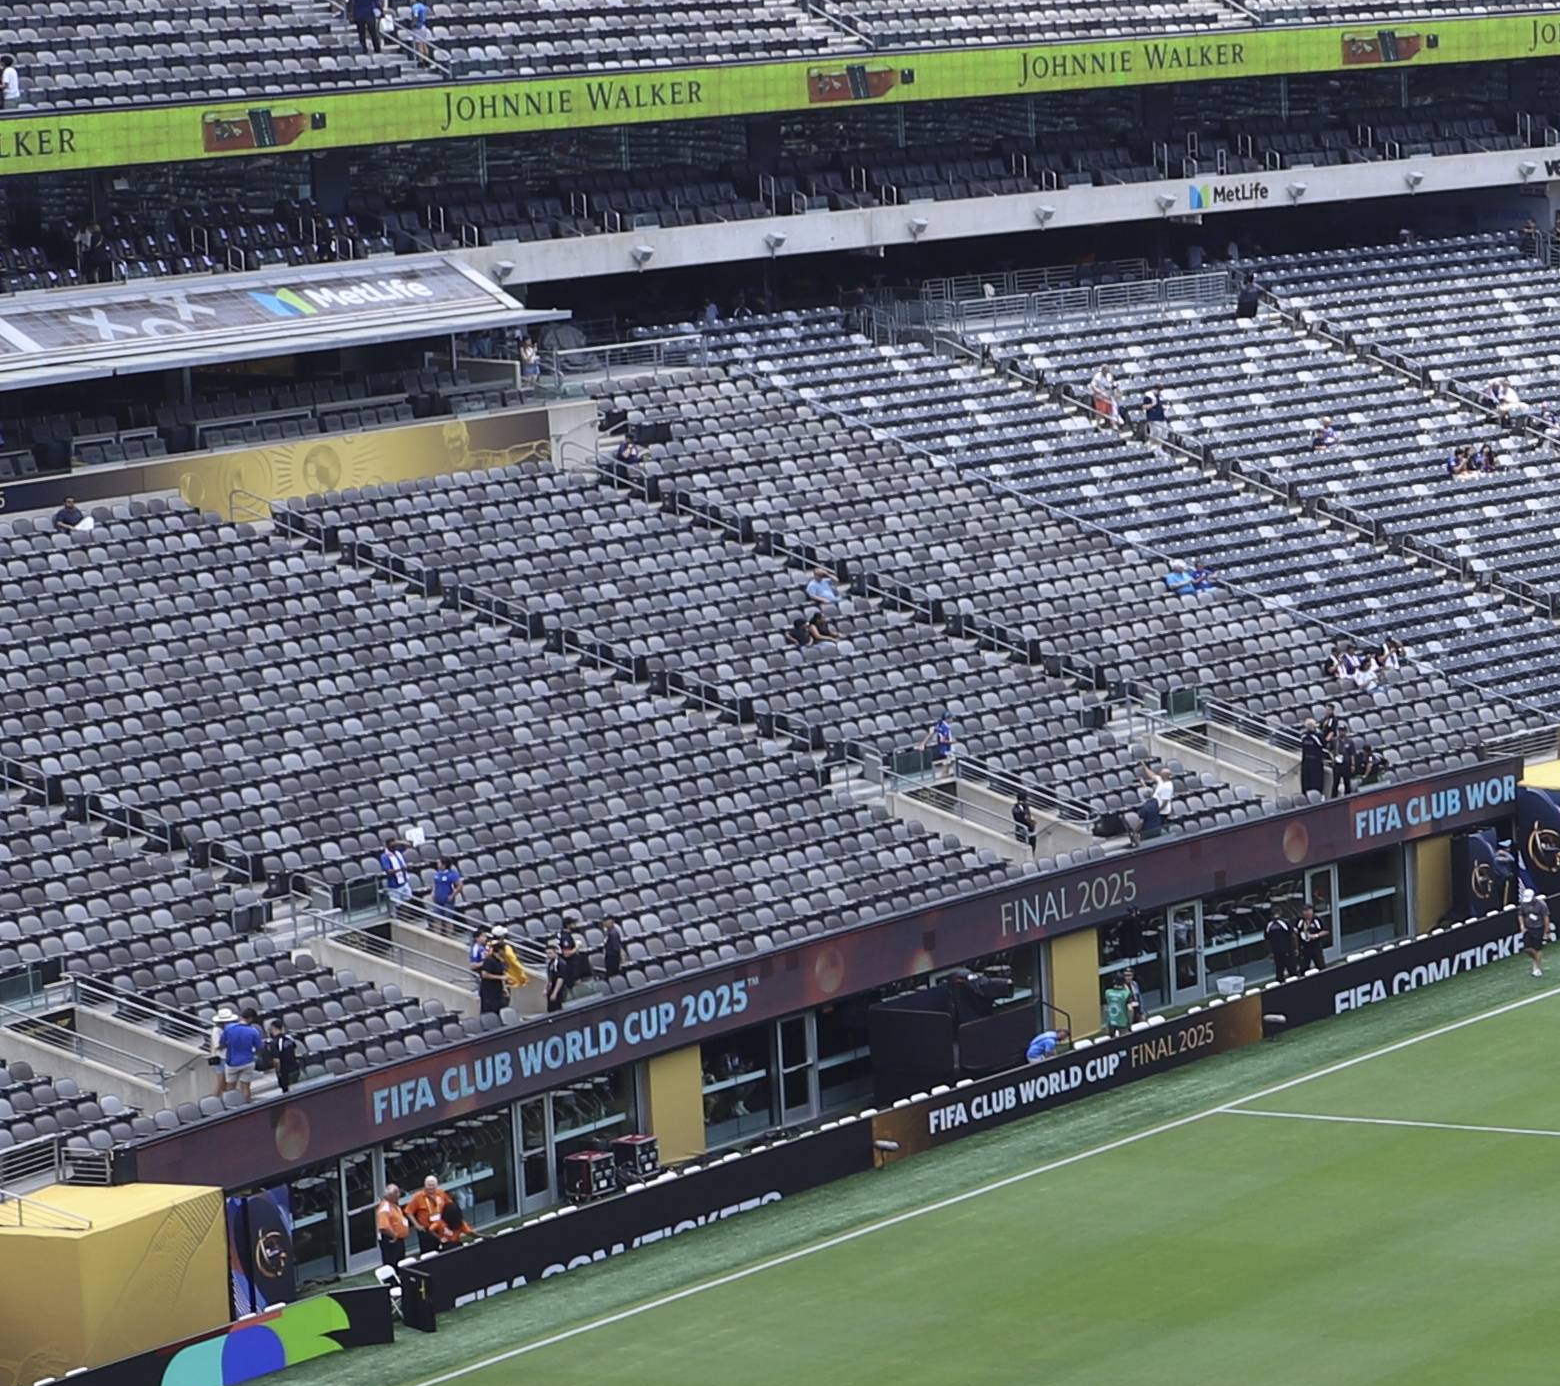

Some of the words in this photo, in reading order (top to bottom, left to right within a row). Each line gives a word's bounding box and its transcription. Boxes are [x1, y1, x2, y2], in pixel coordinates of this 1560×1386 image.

[1018, 50, 1132, 87] JOHNNIE
[1143, 43, 1245, 70] WALKER
[441, 90, 573, 131] JOHNNIE
[586, 80, 703, 112] WALKER
[1213, 182, 1268, 204] MetLife
[304, 277, 433, 313] MetLife
[1355, 803, 1403, 839] FIFA
[1406, 788, 1461, 825] CLUB
[1000, 886, 1074, 938] FINAL
[1077, 869, 1137, 915] 2025
[373, 1077, 436, 1126] FIFA
[440, 1053, 513, 1102] CLUB
[518, 1021, 618, 1079] WORLD
[624, 1001, 675, 1045] CUP
[929, 1097, 968, 1134] FIFA
[971, 1082, 1016, 1121] CLUB
[1018, 1064, 1083, 1109] WORLD
[1131, 1030, 1176, 1068] FINAL
[1179, 1021, 1215, 1058] 2025
